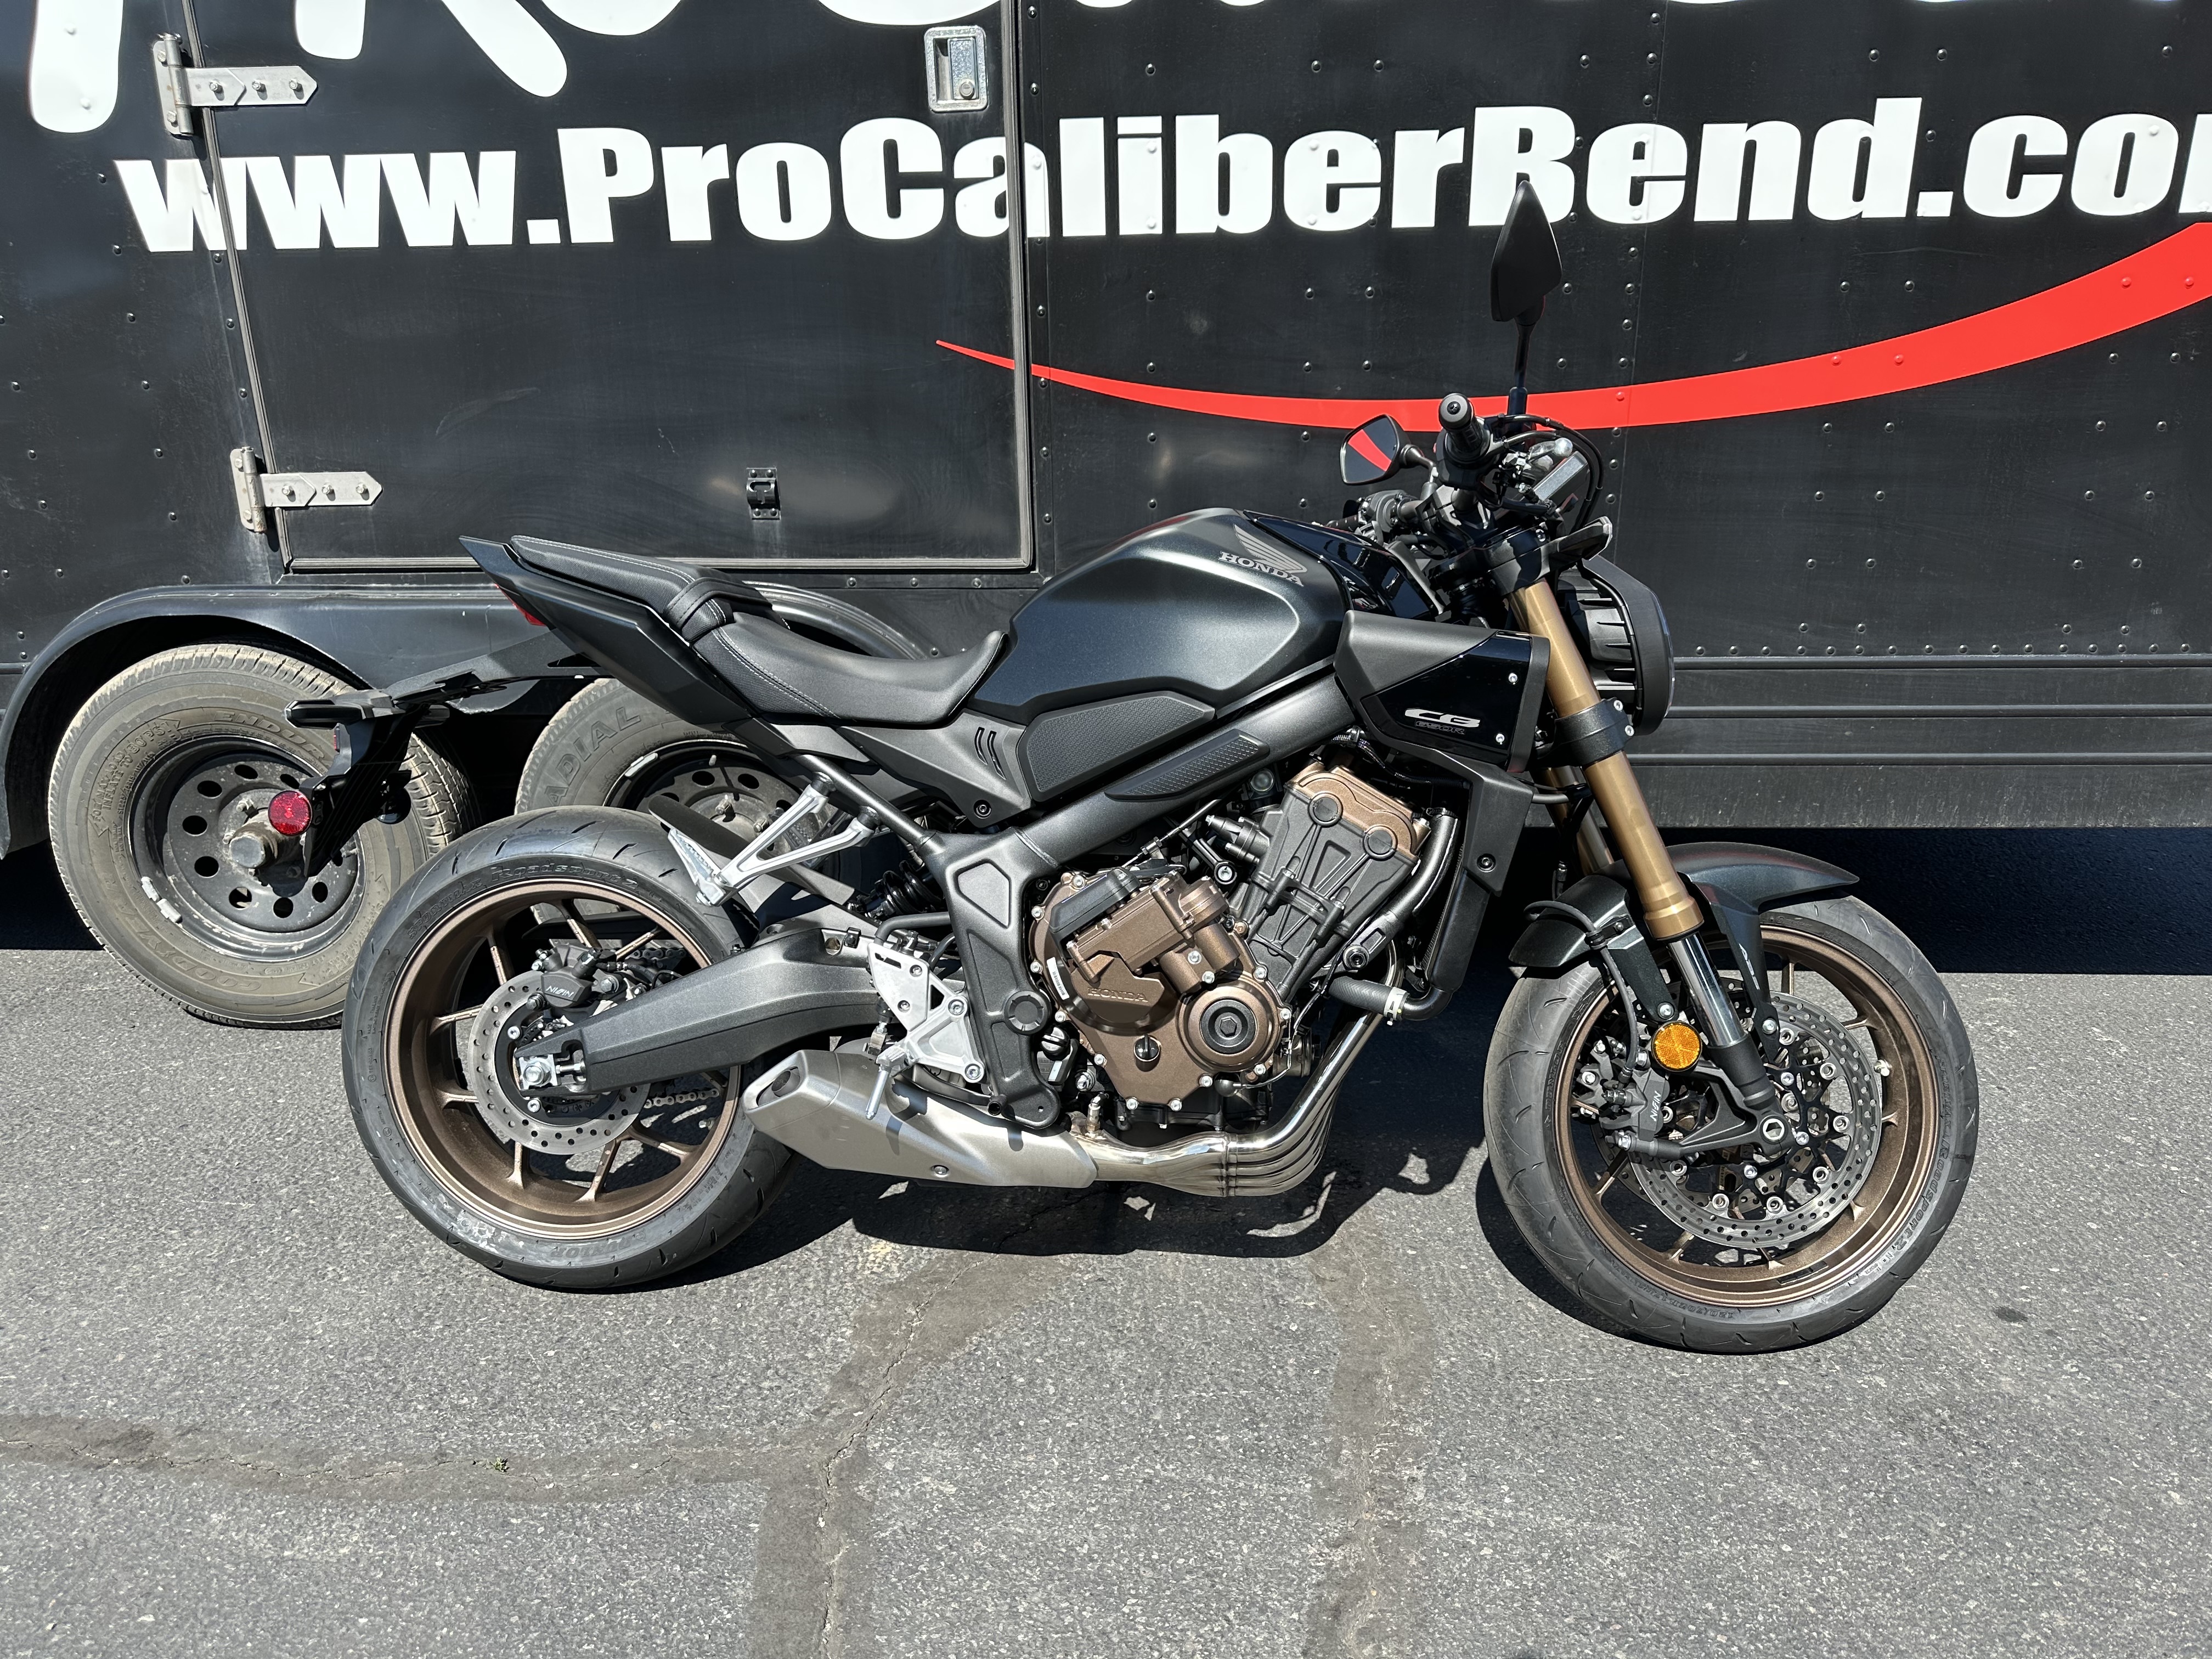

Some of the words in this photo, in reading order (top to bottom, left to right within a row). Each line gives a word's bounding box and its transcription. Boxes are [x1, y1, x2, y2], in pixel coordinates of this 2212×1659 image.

[115, 98, 2212, 252] www.ProCaliberBend.co
[1218, 551, 1304, 587] HONDA
[1405, 708, 1480, 727] CB
[1415, 721, 1465, 735] 650R
[102, 769, 125, 810] INFLATE
[120, 755, 134, 769] TO
[544, 706, 642, 806] ADIAL
[90, 799, 103, 822] FOR
[105, 750, 126, 776] LOAD
[104, 878, 262, 991] GOODYEAR
[408, 878, 487, 939] SPORTMAX
[546, 986, 575, 998] NISSIN
[1087, 988, 1149, 1002] HONDA
[1650, 1090, 1662, 1122] NISSIN
[1904, 1139, 1951, 1238] Roadsport
